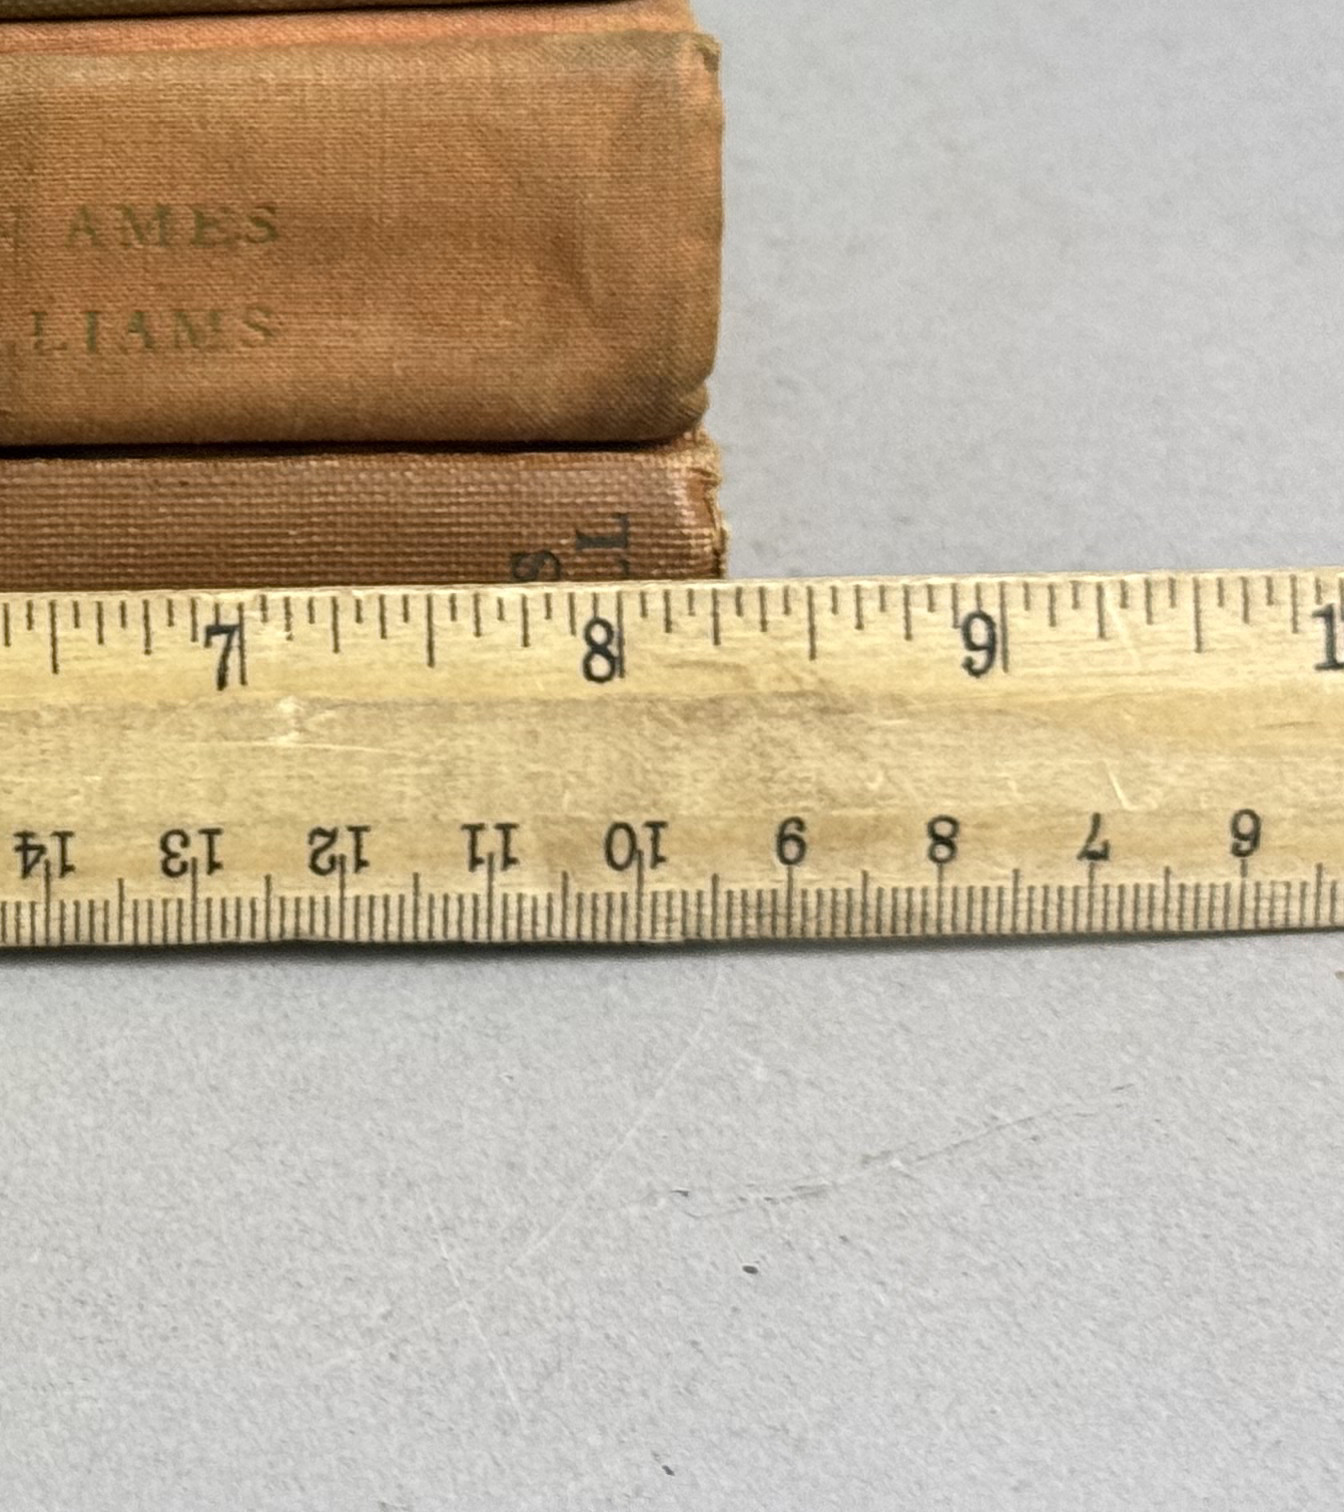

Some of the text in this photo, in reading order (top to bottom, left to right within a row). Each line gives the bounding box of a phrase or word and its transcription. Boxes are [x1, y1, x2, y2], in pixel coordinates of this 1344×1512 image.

[64, 201, 280, 250] AMES
[204, 624, 240, 690] 7
[583, 618, 617, 683] 8
[961, 610, 997, 677] 9
[1314, 604, 1344, 671] 1
[13, 830, 76, 878] 14
[160, 828, 223, 877] 13
[308, 825, 370, 874] 12
[462, 822, 520, 872] 11
[604, 820, 667, 871] 10
[775, 817, 809, 865] 9
[926, 815, 960, 863] 8
[1077, 811, 1111, 862] 7
[1230, 808, 1261, 857] 6
